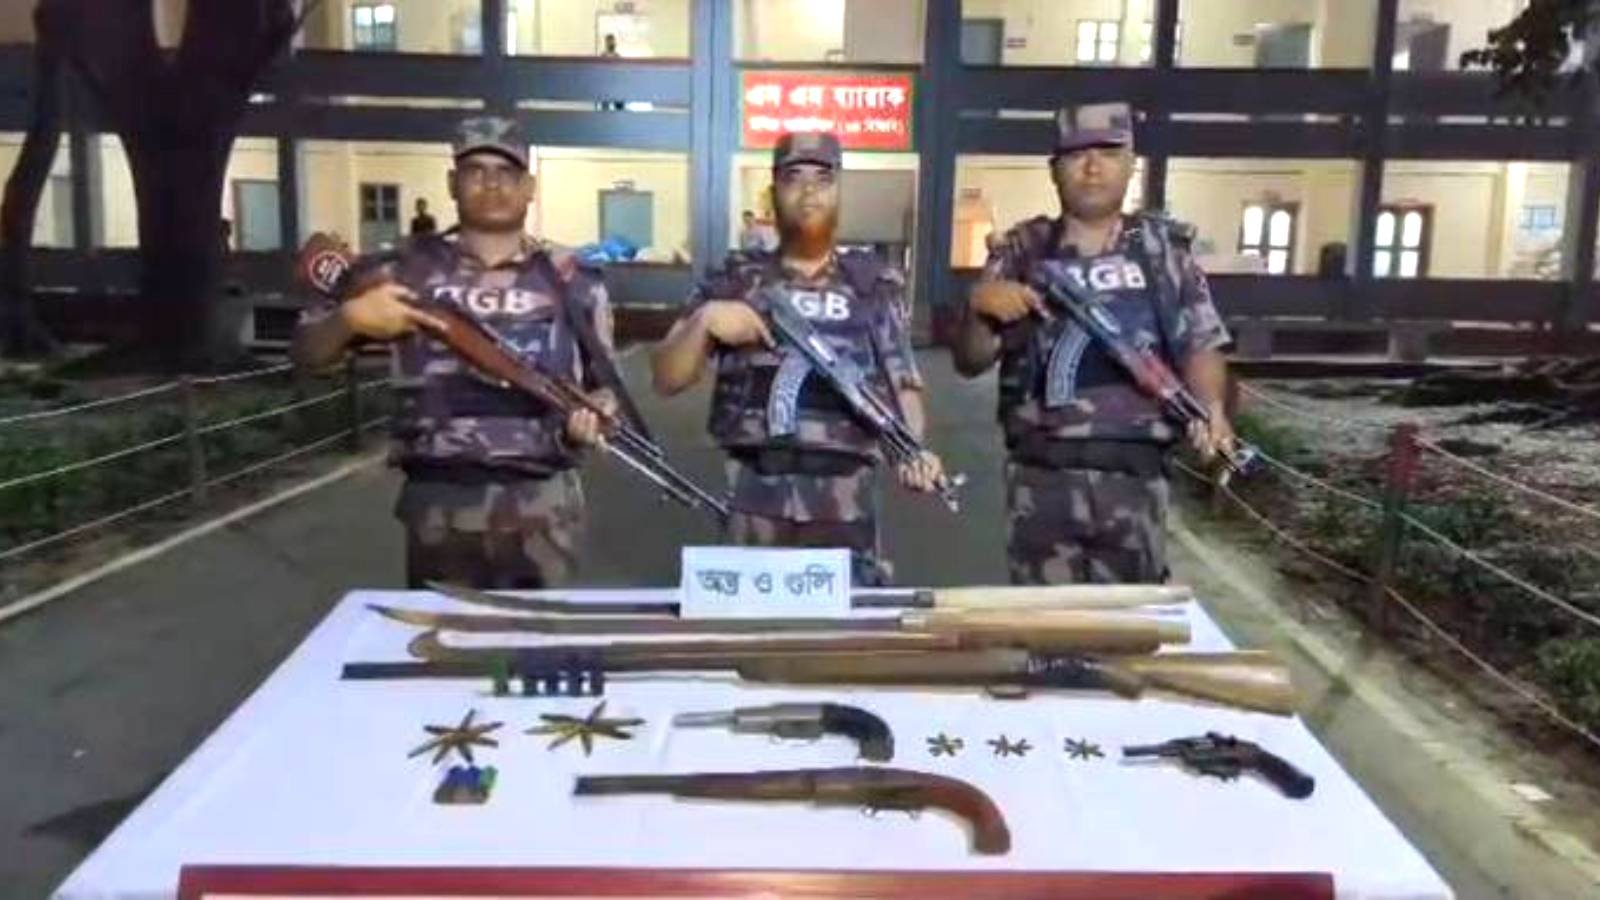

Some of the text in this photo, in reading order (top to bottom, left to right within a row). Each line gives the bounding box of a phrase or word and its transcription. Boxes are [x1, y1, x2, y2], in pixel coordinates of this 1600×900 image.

[791, 290, 850, 321] GB
[753, 571, 773, 594] ও
[784, 564, 836, 596] গুলি
